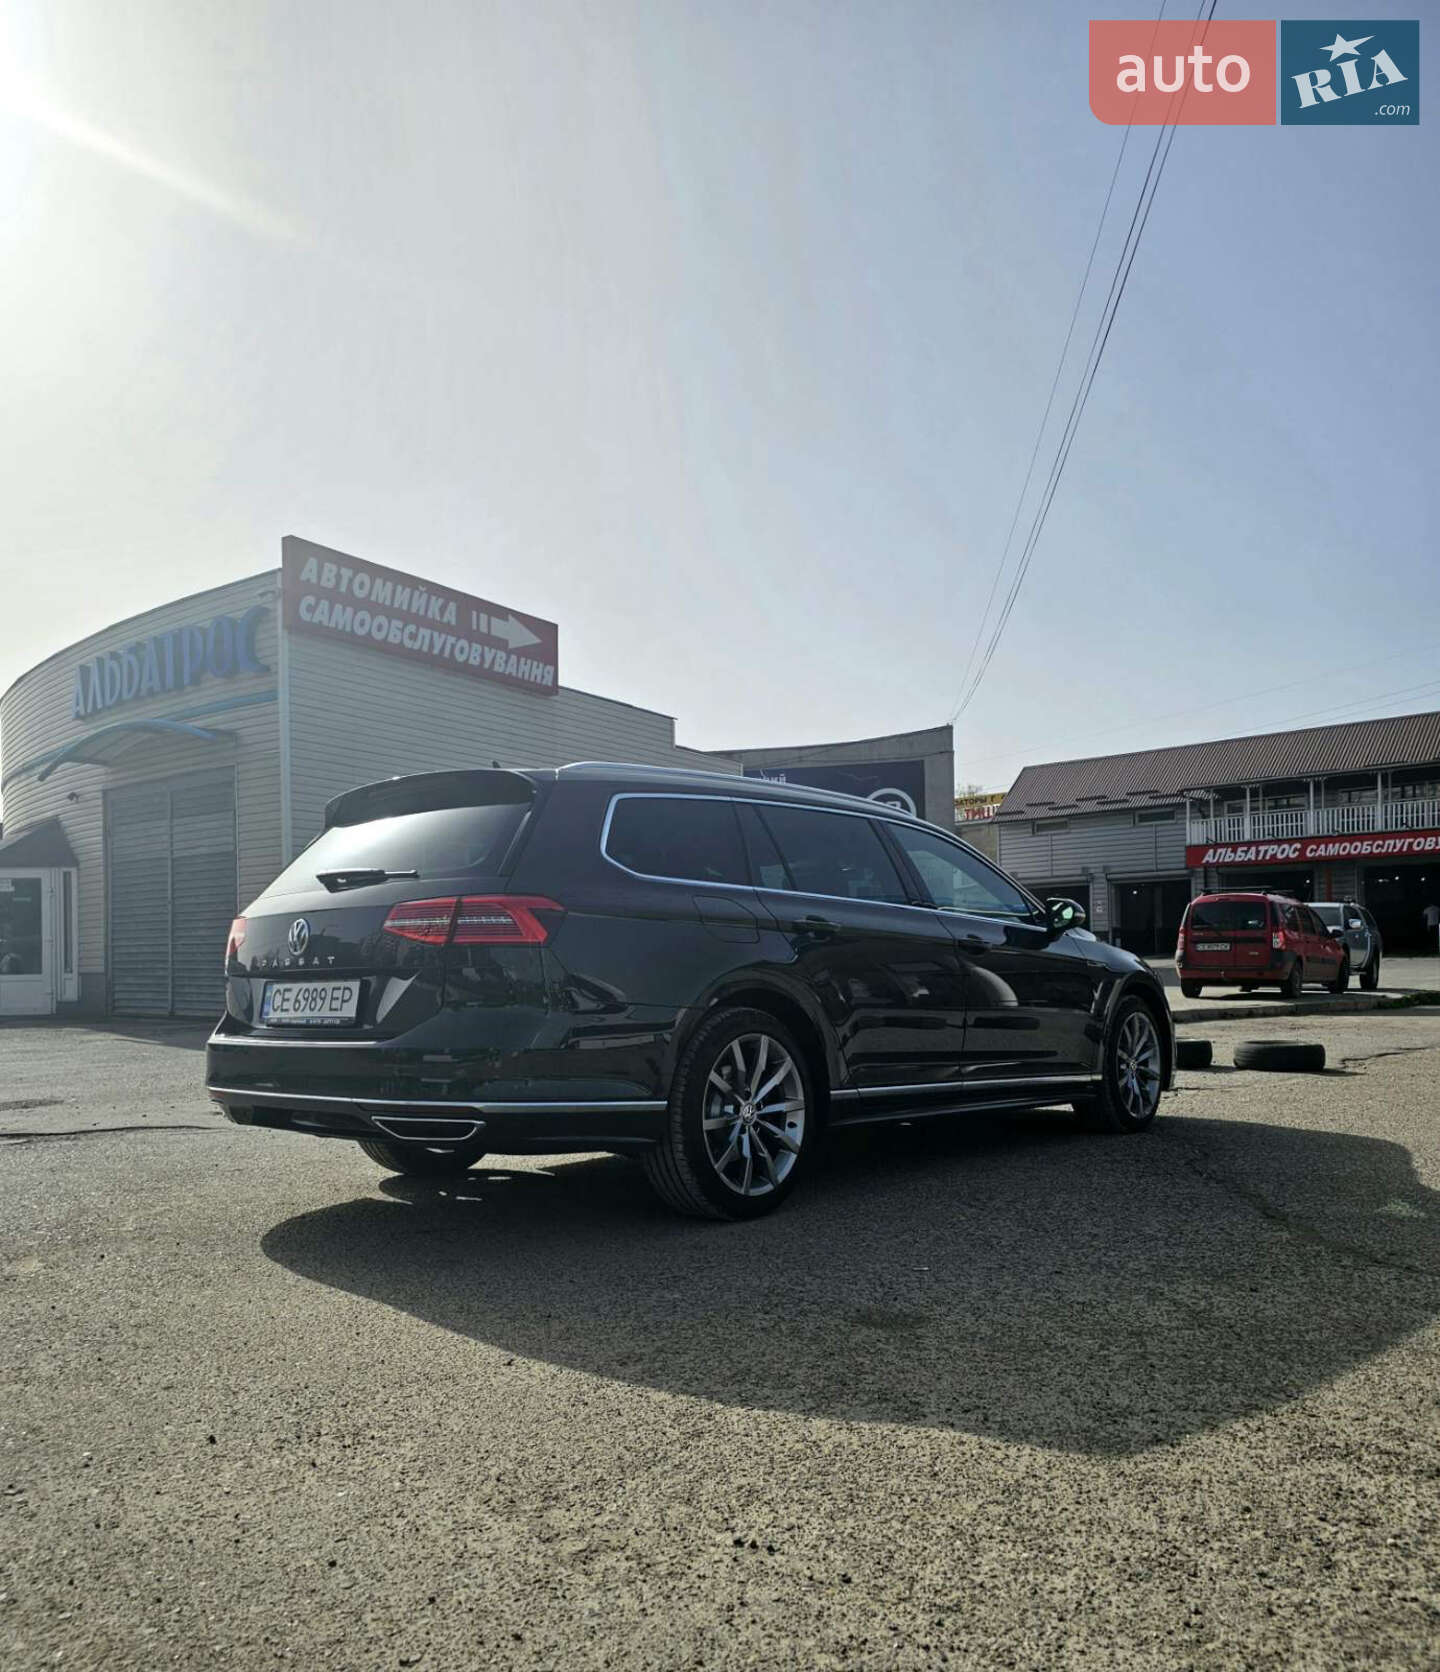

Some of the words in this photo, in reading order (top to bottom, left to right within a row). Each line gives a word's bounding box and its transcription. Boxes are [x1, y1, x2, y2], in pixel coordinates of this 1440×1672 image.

[301, 557, 458, 626] АВТОМИЙКА
[299, 595, 555, 687] САМООБСЛУГОВУВАННЯ
[1202, 843, 1302, 864] АЛЬБАТРОС
[271, 988, 292, 1012] CE
[293, 987, 327, 1012] 6989
[329, 986, 353, 1011] EP
